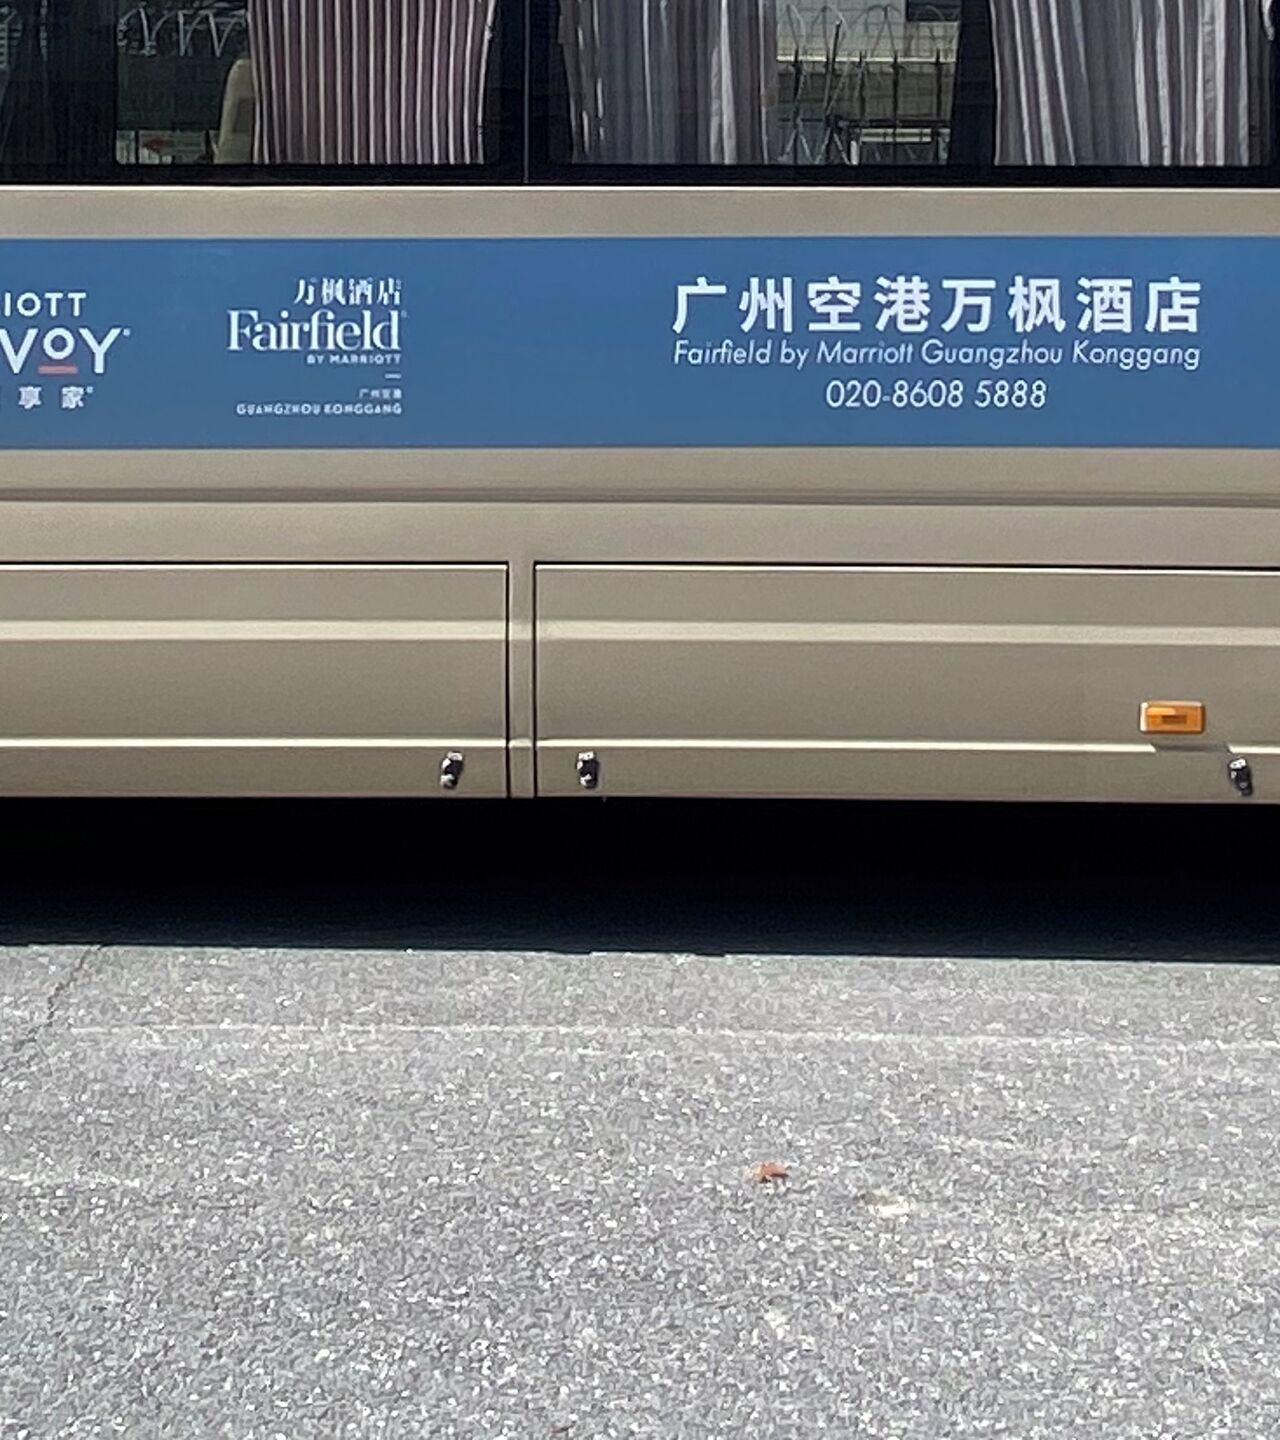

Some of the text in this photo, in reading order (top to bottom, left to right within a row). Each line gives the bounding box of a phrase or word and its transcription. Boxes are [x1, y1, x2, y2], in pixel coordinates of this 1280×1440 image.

[294, 277, 402, 306] 万枫酒店
[672, 275, 1201, 334] 广州空港万枫酒店
[228, 309, 401, 351] Fairfield
[307, 354, 401, 364] BY MARRIOTT
[674, 338, 1200, 370] Fairfield by Marriott Guangzhou Konggang
[826, 379, 1047, 408] 020-8608 5888
